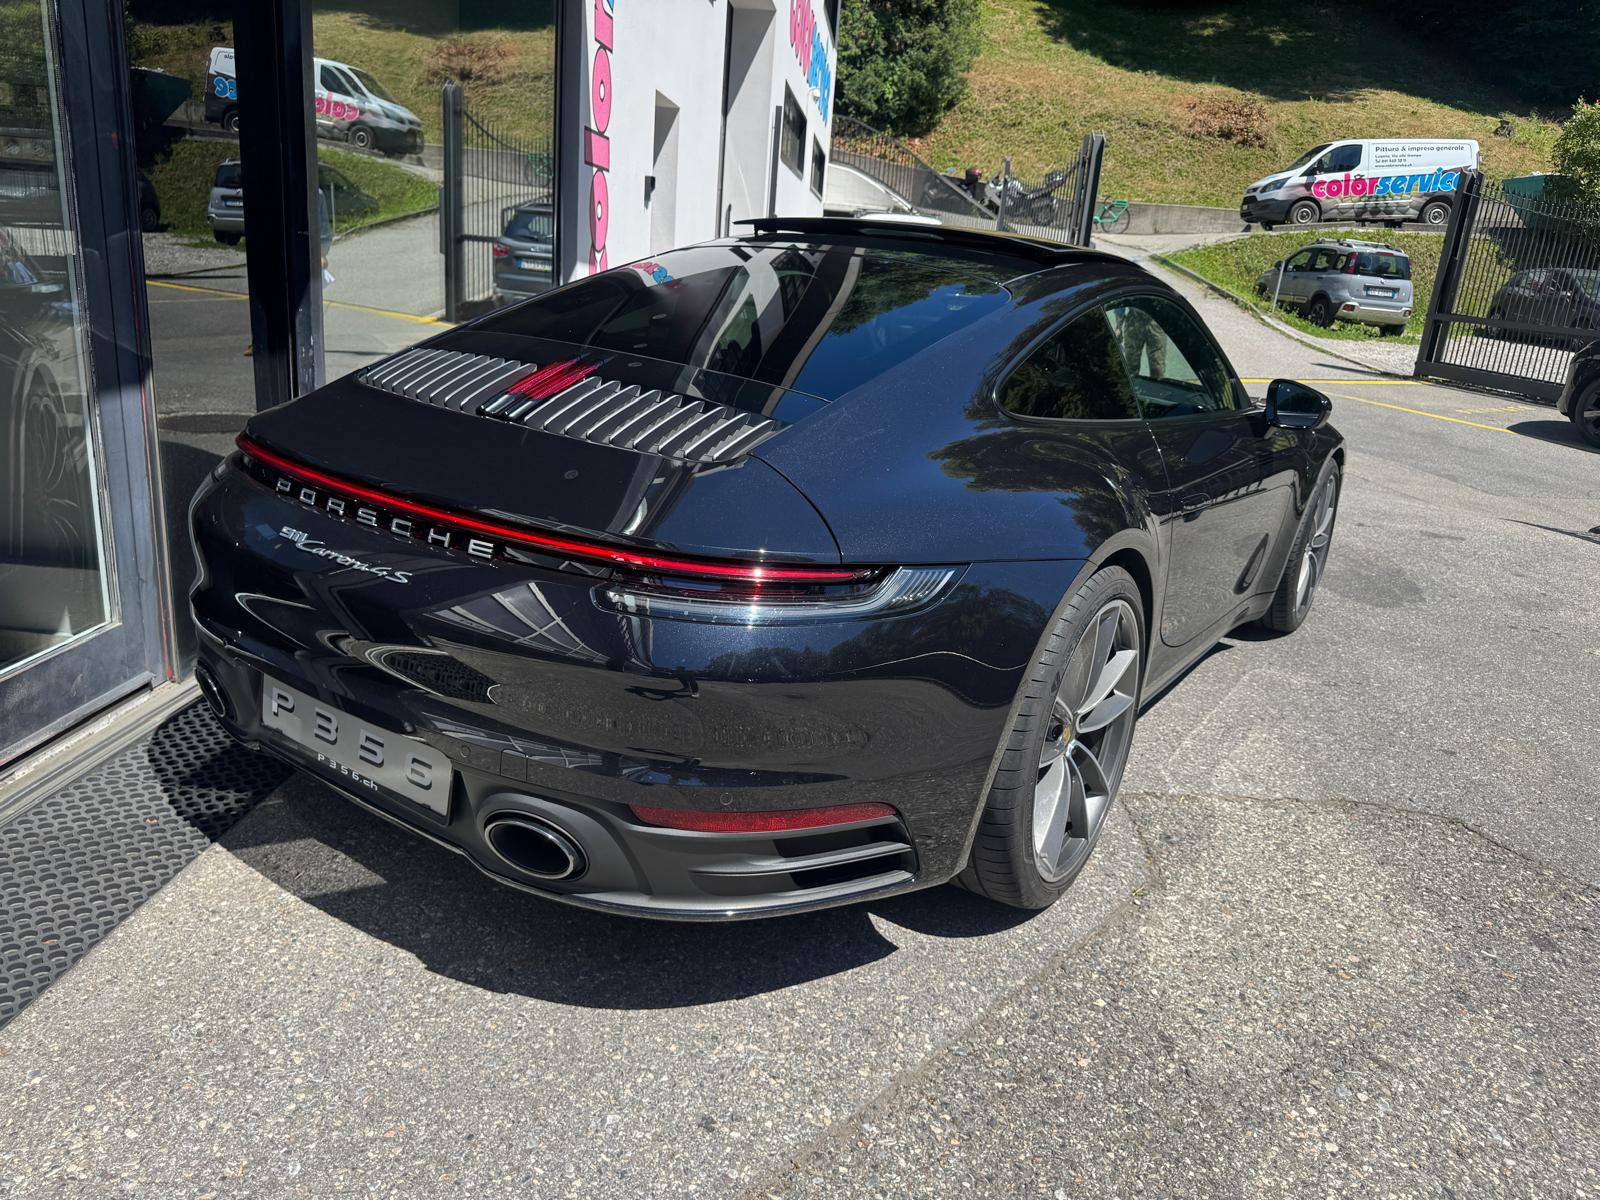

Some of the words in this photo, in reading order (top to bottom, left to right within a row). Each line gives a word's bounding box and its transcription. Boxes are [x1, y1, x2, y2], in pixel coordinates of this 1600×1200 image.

[1407, 145, 1435, 153] impresa
[275, 477, 495, 560] PORSCHE
[279, 525, 309, 542] 911
[295, 539, 371, 571] Carrera
